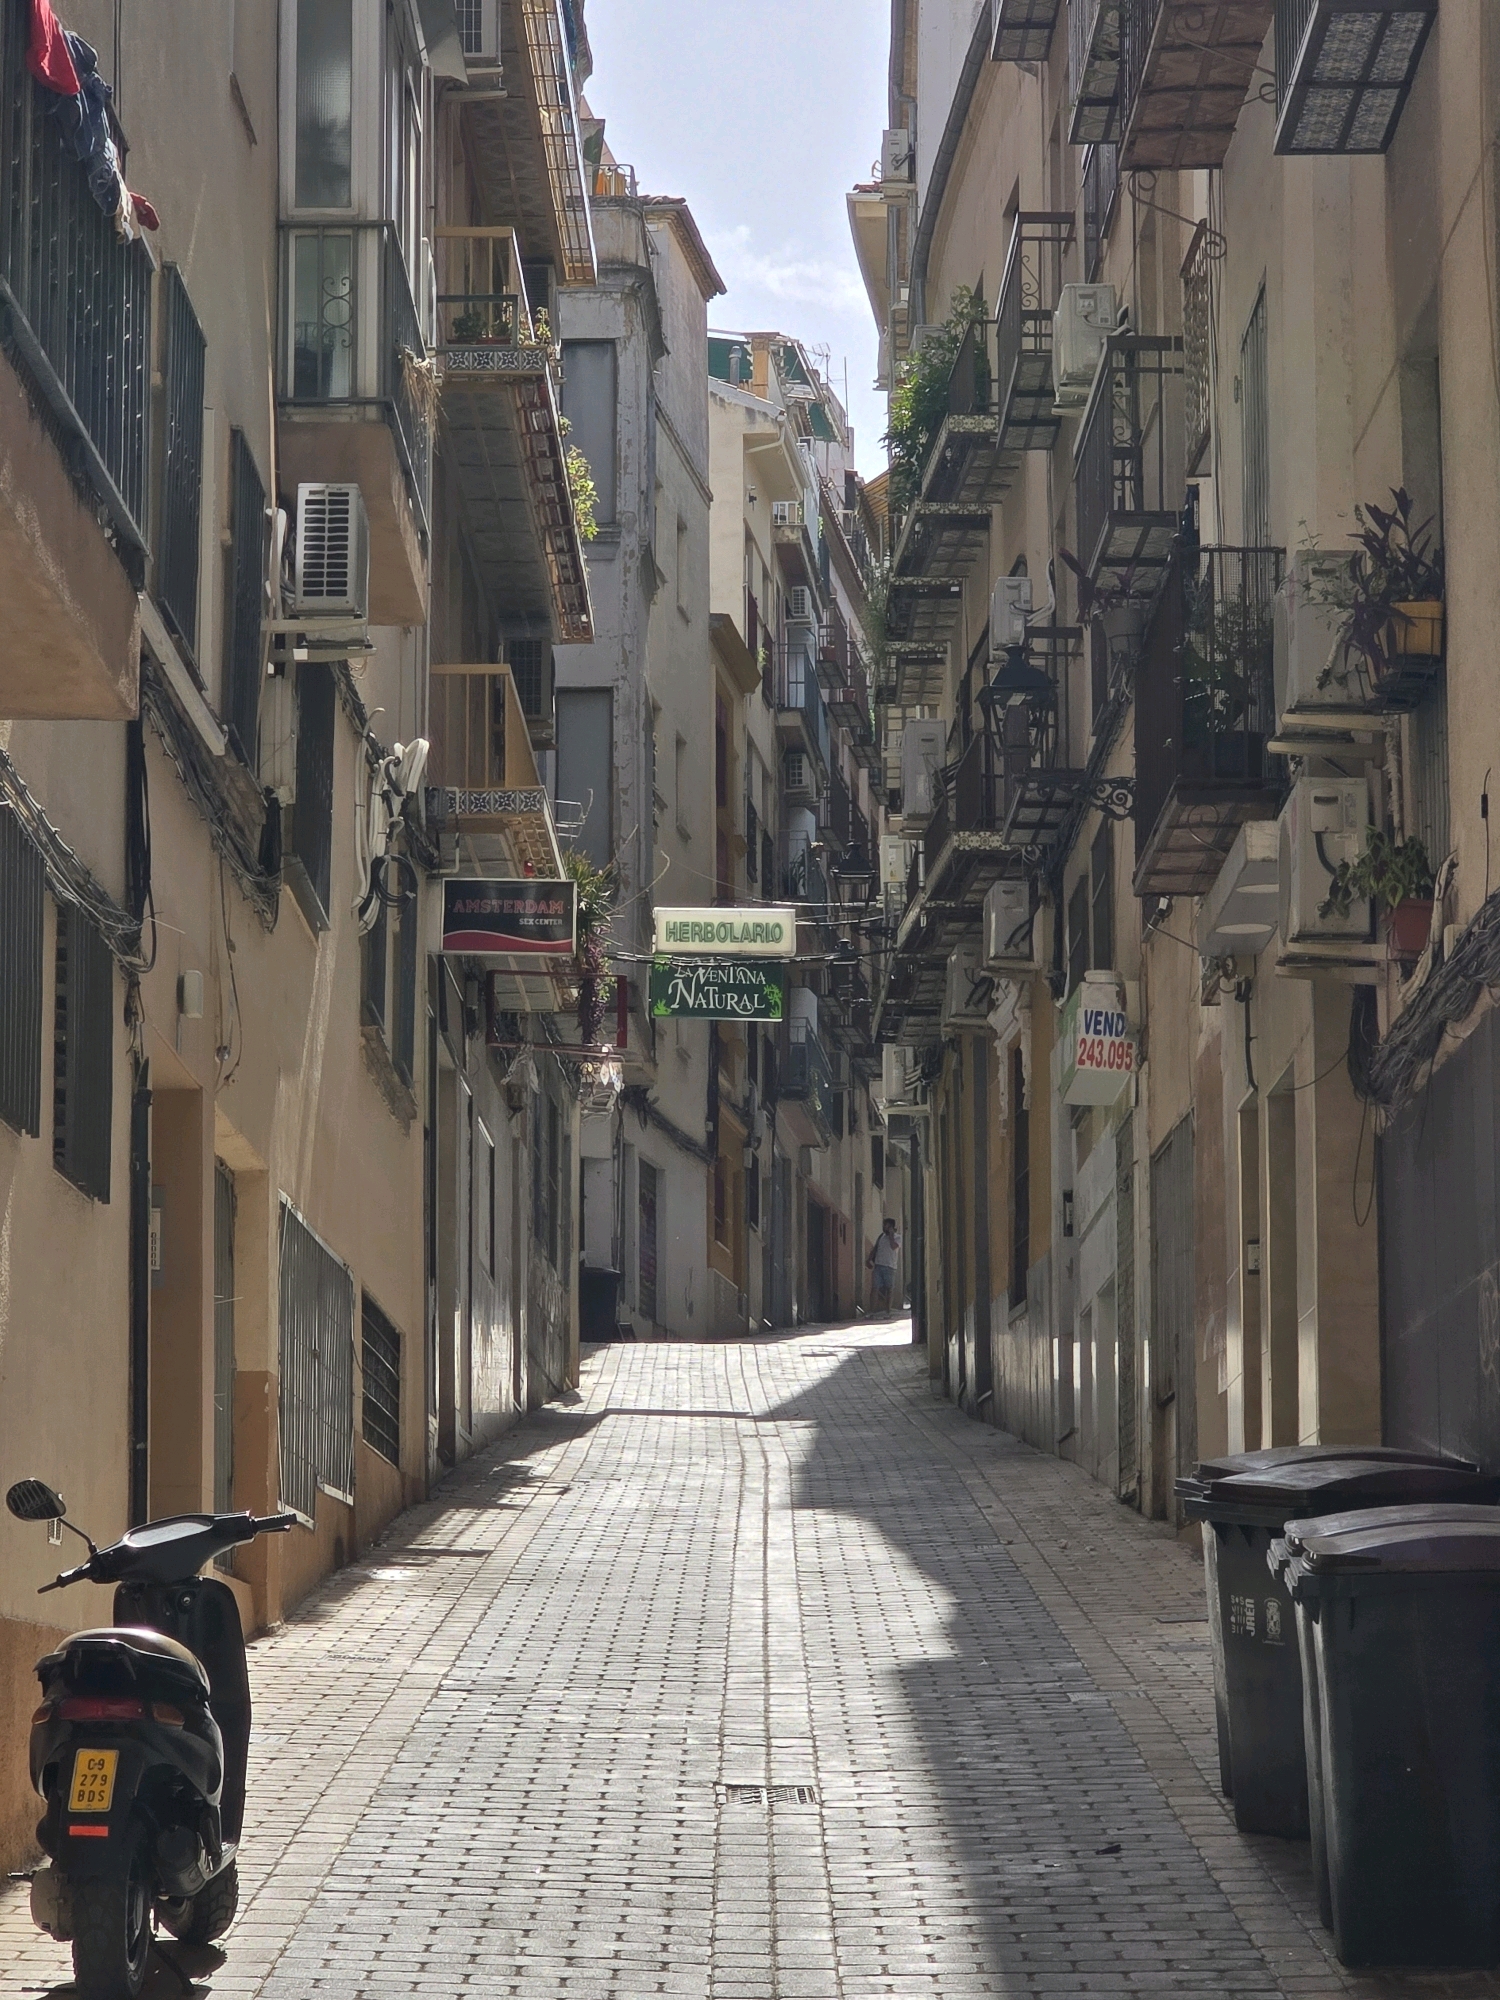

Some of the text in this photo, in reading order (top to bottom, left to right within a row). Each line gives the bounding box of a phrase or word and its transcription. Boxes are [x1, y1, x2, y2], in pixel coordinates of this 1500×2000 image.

[453, 899, 564, 914] AMSTERDAM
[535, 918, 563, 926] CENTER
[665, 921, 784, 943] HERBOLARIO
[674, 966, 767, 985] LA VENTANA
[668, 974, 766, 1015] NATURAL
[1077, 1037, 1134, 1071] 243.095
[80, 1774, 108, 1787] 279
[77, 1789, 106, 1803] BDS
